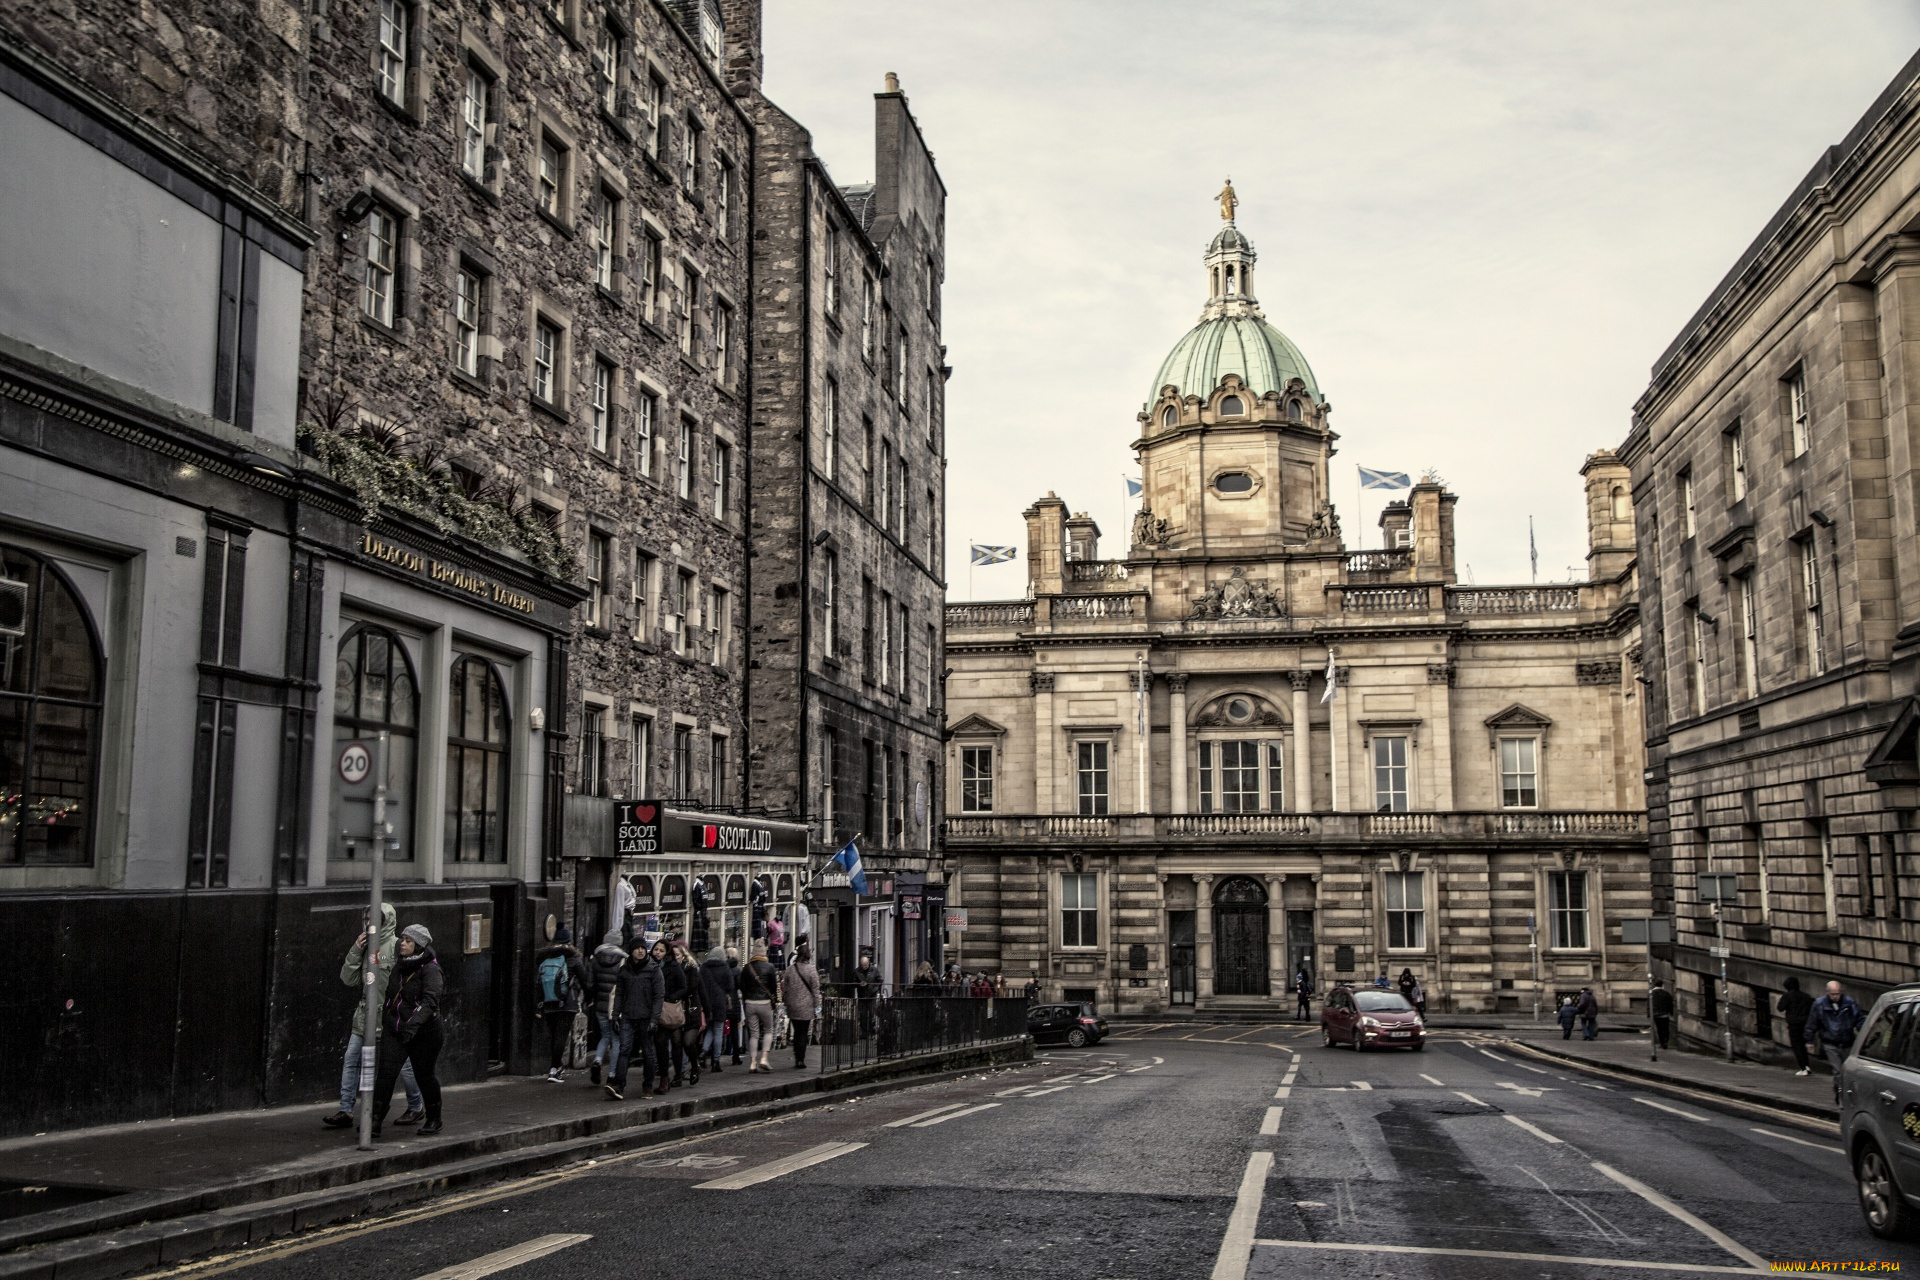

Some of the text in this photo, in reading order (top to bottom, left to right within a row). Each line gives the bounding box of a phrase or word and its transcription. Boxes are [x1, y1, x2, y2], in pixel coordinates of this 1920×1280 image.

[364, 533, 424, 572] DEACON
[492, 582, 536, 614] TAVERN
[343, 755, 367, 773] 20
[620, 805, 632, 825] I
[618, 825, 657, 839] SCOT
[718, 826, 772, 852] SCOTLAND
[618, 839, 657, 853] LAND
